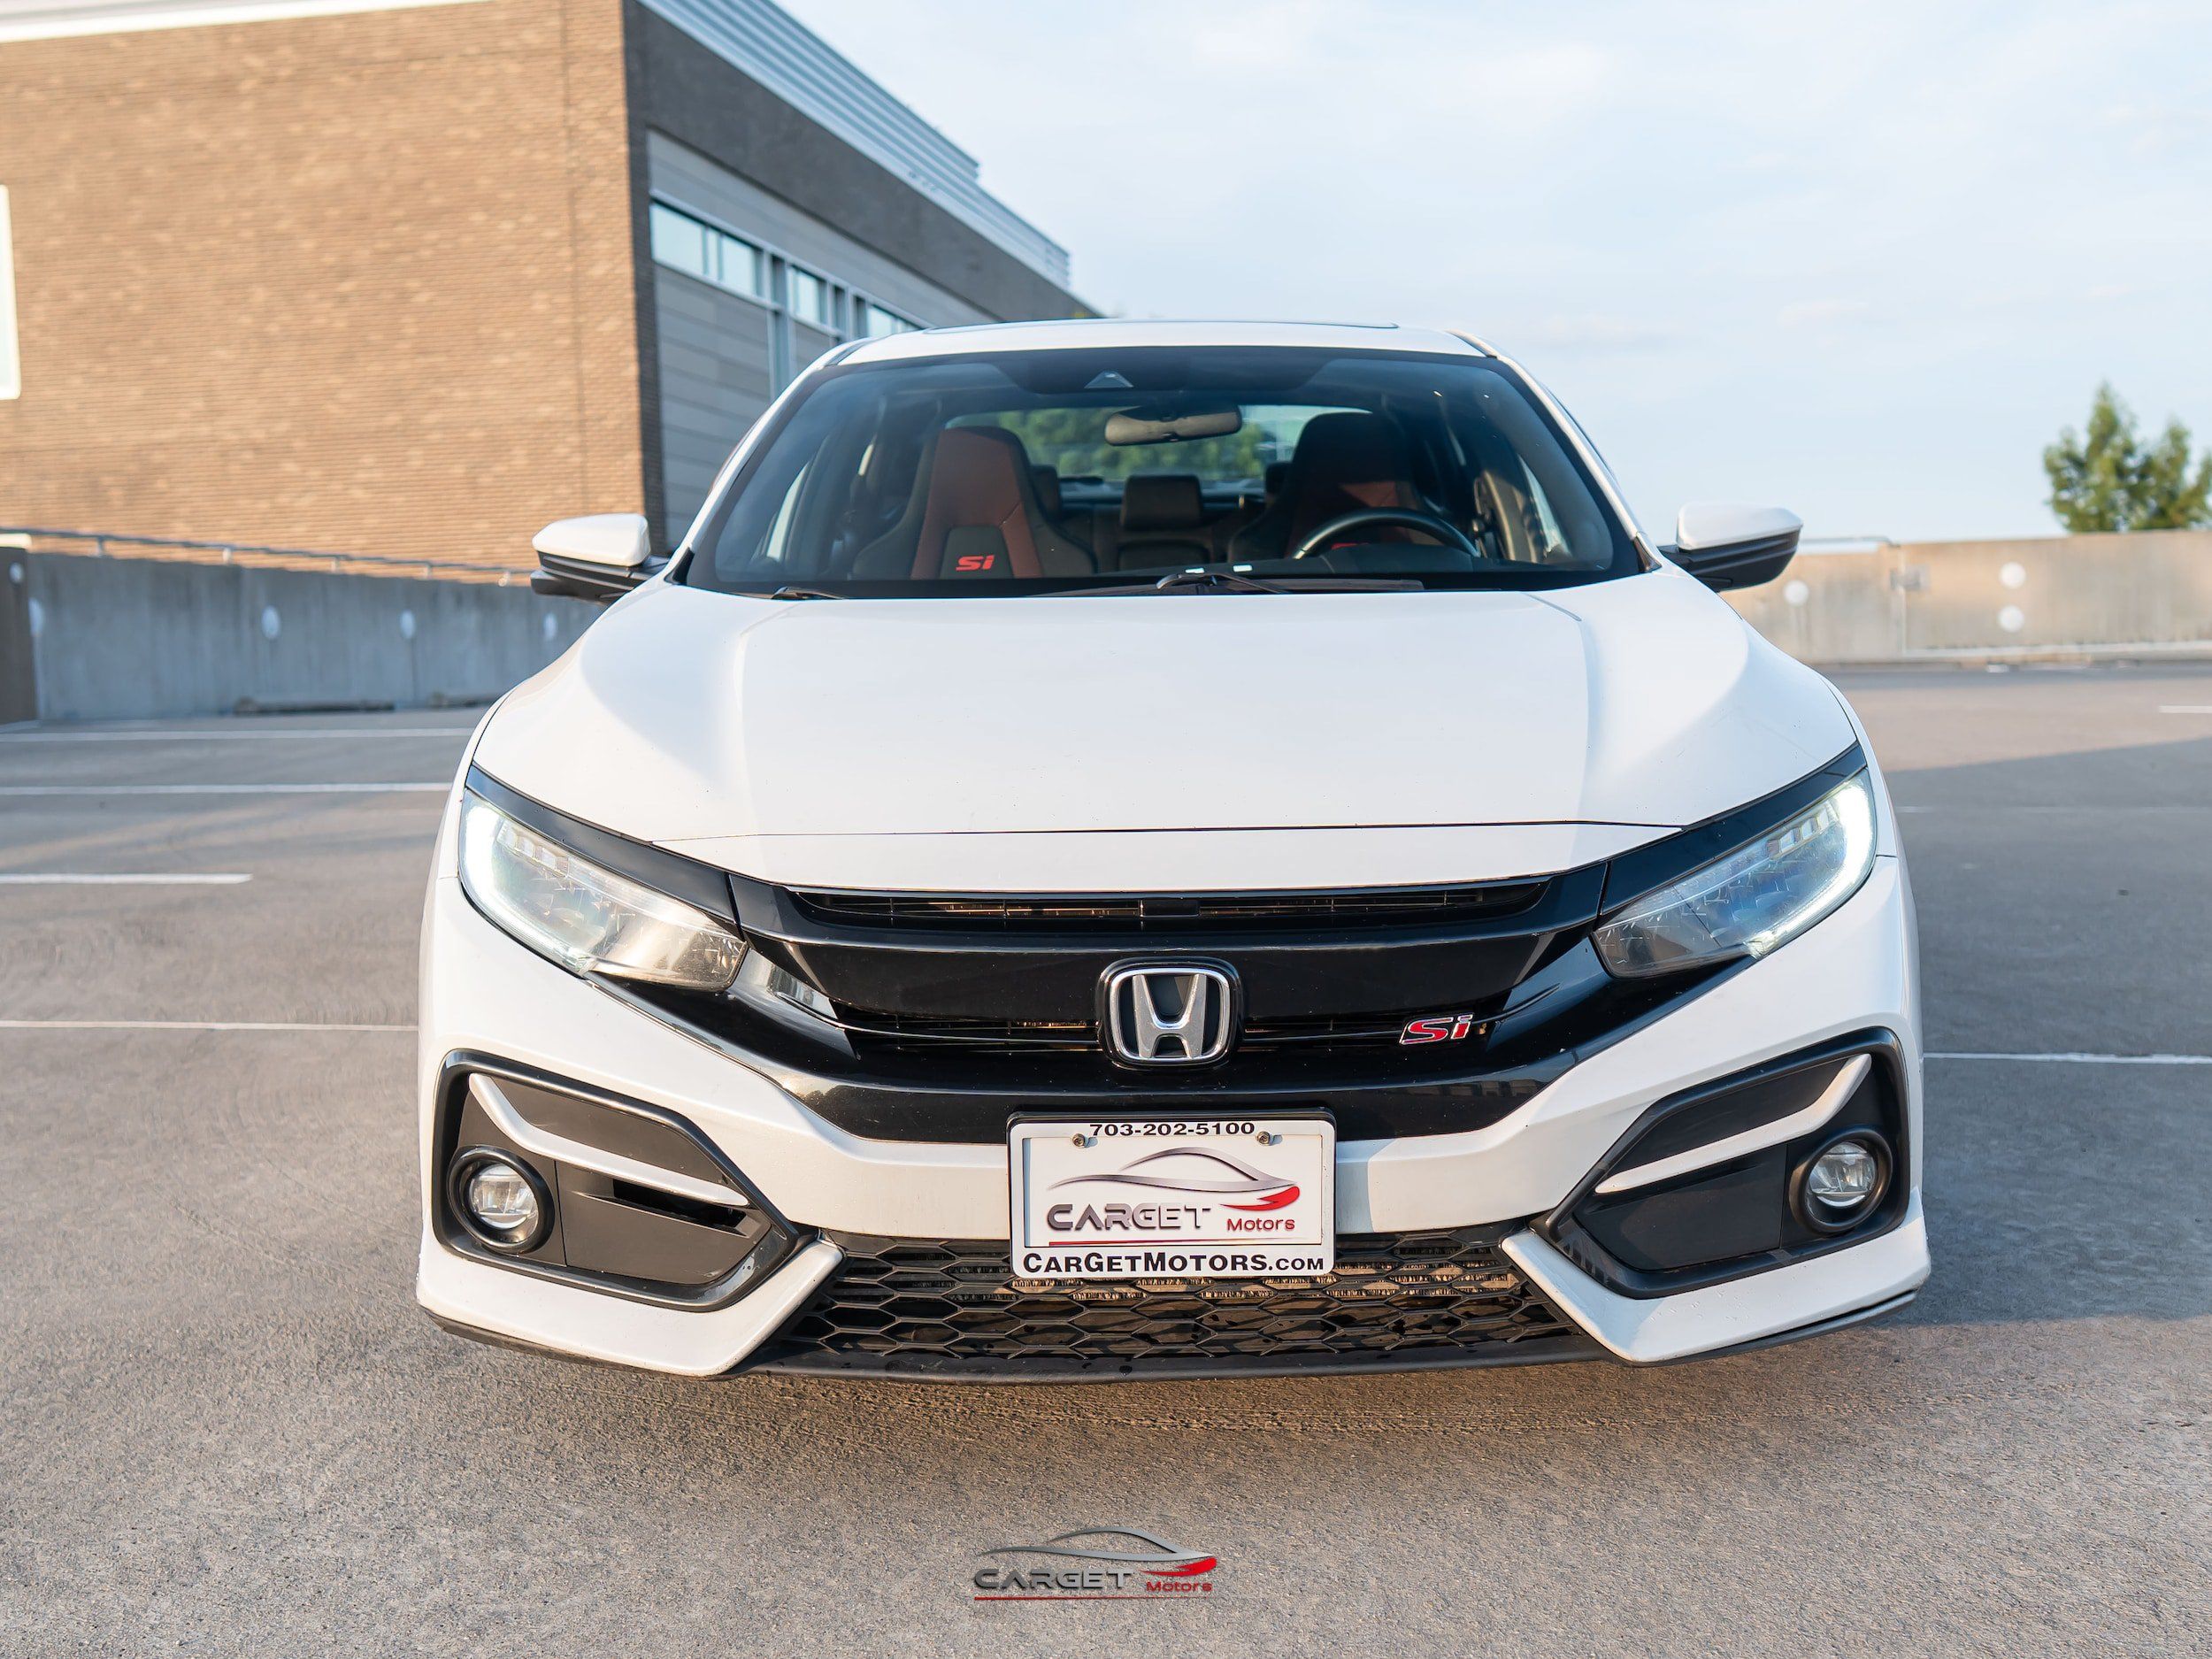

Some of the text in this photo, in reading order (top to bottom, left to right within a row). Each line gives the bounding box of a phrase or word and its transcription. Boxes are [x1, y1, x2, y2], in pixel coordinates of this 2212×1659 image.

[1399, 1013, 1473, 1045] Si
[1089, 1122, 1256, 1137] 703-202-5100
[1046, 1203, 1296, 1232] CARGET Motors
